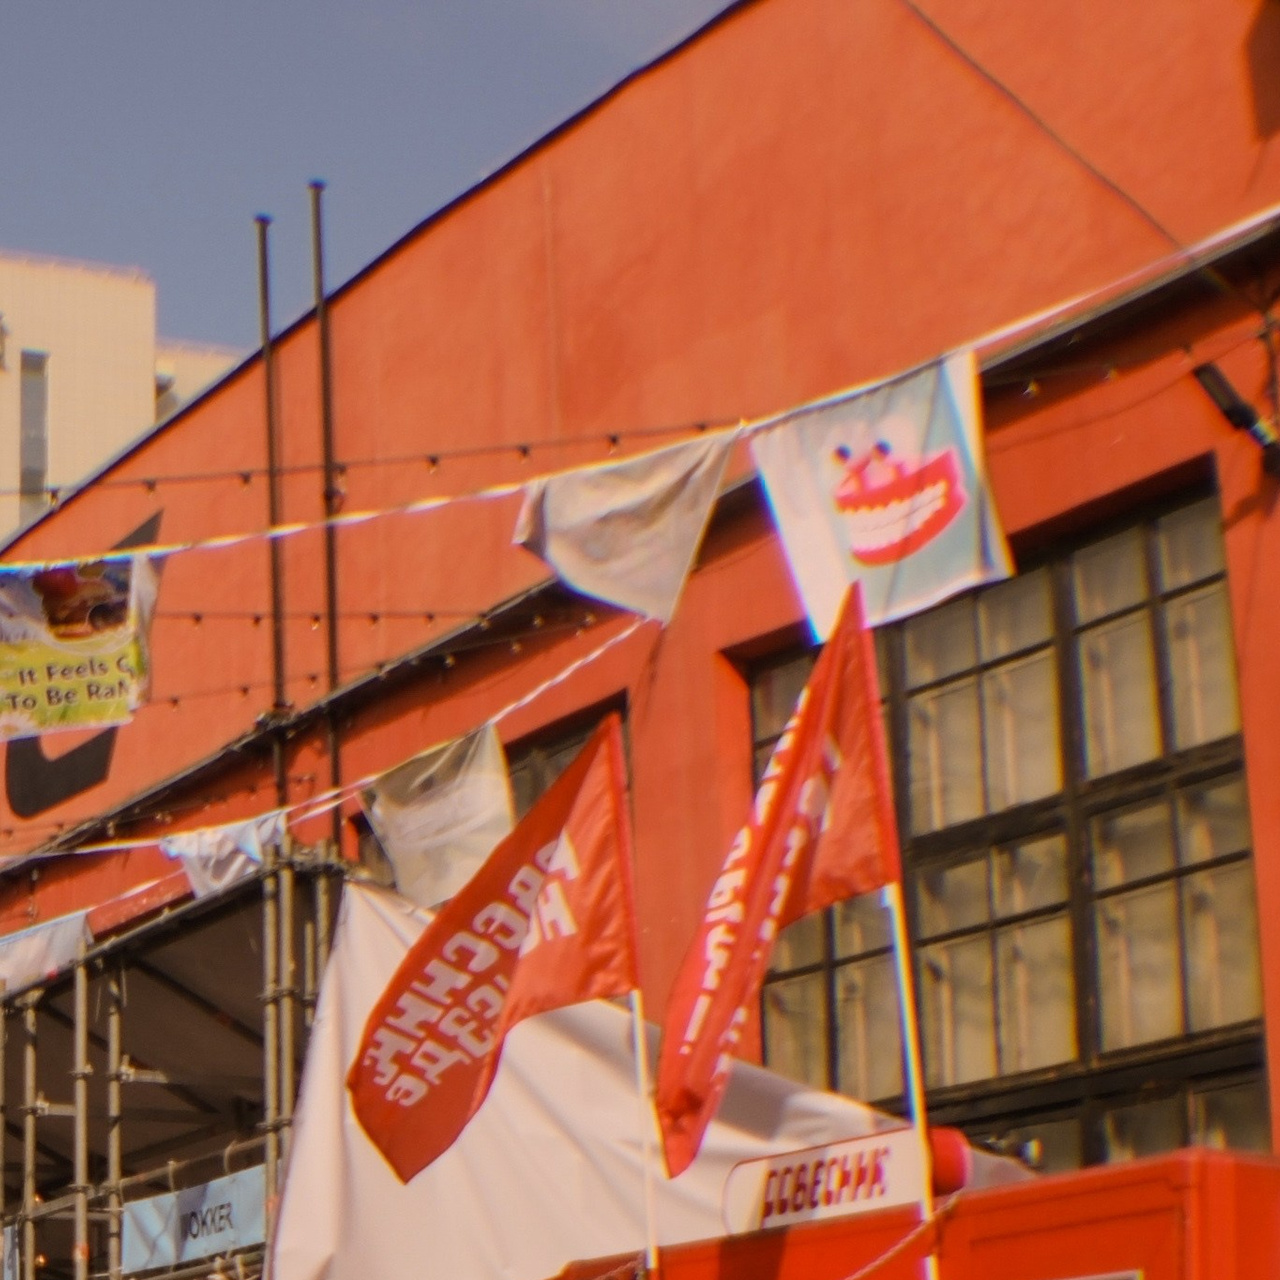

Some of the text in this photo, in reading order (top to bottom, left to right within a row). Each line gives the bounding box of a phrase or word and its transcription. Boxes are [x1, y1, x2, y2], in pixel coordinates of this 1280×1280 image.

[18, 669, 37, 685] It
[46, 657, 109, 681] Feels
[6, 694, 37, 711] To
[46, 687, 78, 706] Be
